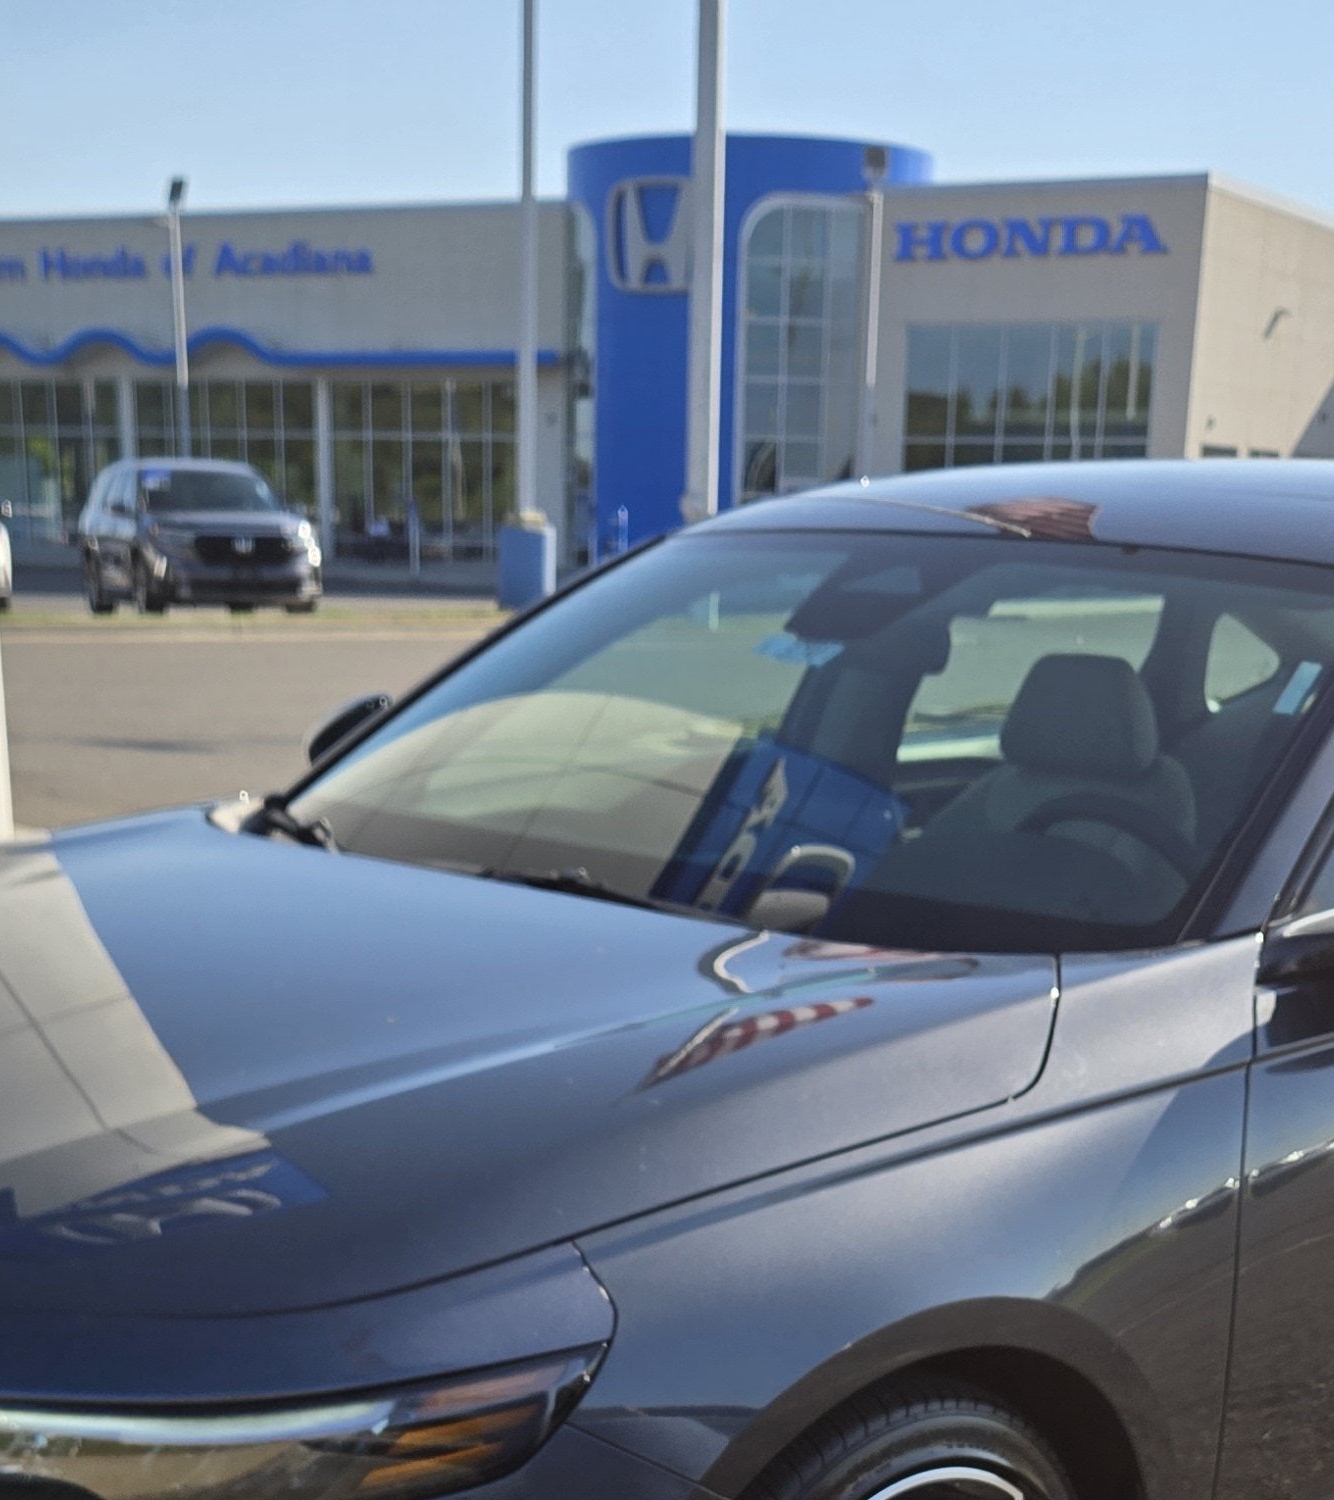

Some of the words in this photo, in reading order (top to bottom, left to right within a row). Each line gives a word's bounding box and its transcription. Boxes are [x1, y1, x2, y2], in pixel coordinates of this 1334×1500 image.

[36, 245, 148, 281] Honda
[212, 238, 375, 277] Acadiana
[893, 212, 1168, 262] HONDA
